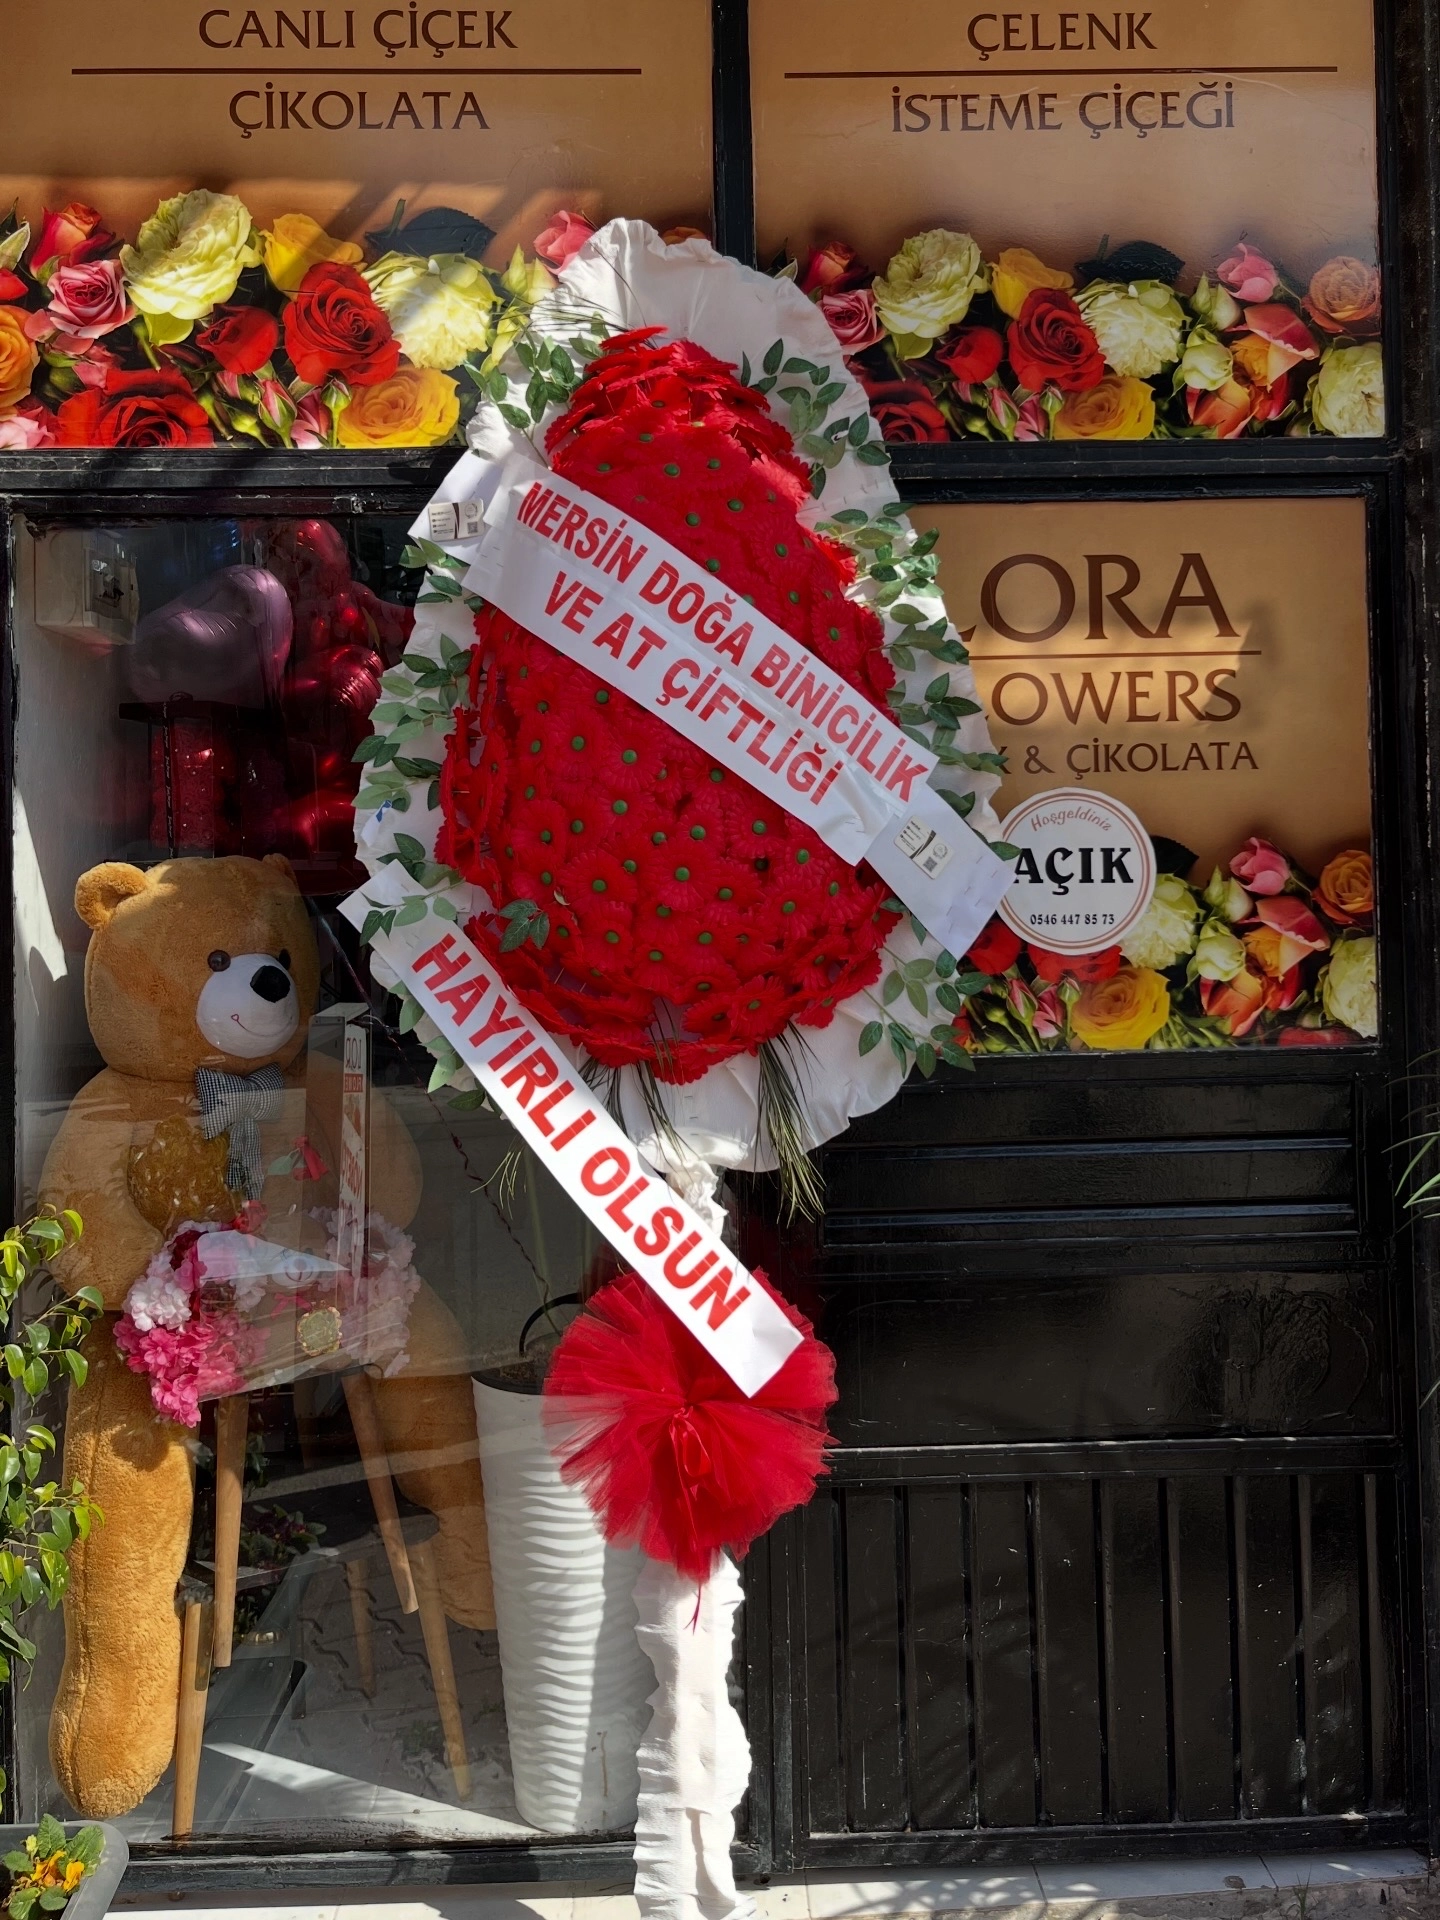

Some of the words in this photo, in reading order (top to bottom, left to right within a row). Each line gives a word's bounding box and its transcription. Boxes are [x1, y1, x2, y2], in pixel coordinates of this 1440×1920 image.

[199, 9, 355, 49] CANLI
[373, 1, 518, 58] ÇİÇEK
[967, 12, 1157, 61] ÇELENK
[229, 82, 490, 139] ÇİKOLATA
[891, 85, 1063, 133] İSTEME
[1079, 81, 1235, 139] ÇİÇEĞİ
[958, 553, 1241, 643] ORA
[517, 482, 648, 583] MERSİN
[640, 560, 755, 666] DOĞA
[751, 644, 929, 802] BİNİCİLİK
[544, 571, 603, 634] VE
[592, 612, 667, 671] AT
[656, 658, 844, 805] ÇİFTLİĞİ
[985, 668, 1242, 727] OWERS
[1023, 744, 1056, 775] &
[1066, 737, 1260, 780] ÇİKOLATA
[1030, 806, 1113, 832] Hoşgeldiniz
[1013, 847, 1134, 896] AÇIK
[1030, 913, 1057, 925] 0546
[1060, 913, 1080, 925] 447
[1084, 913, 1098, 925] 85
[1102, 913, 1115, 925] 73
[412, 933, 597, 1153] HAYIRLI
[580, 1145, 752, 1332] OLSUN
